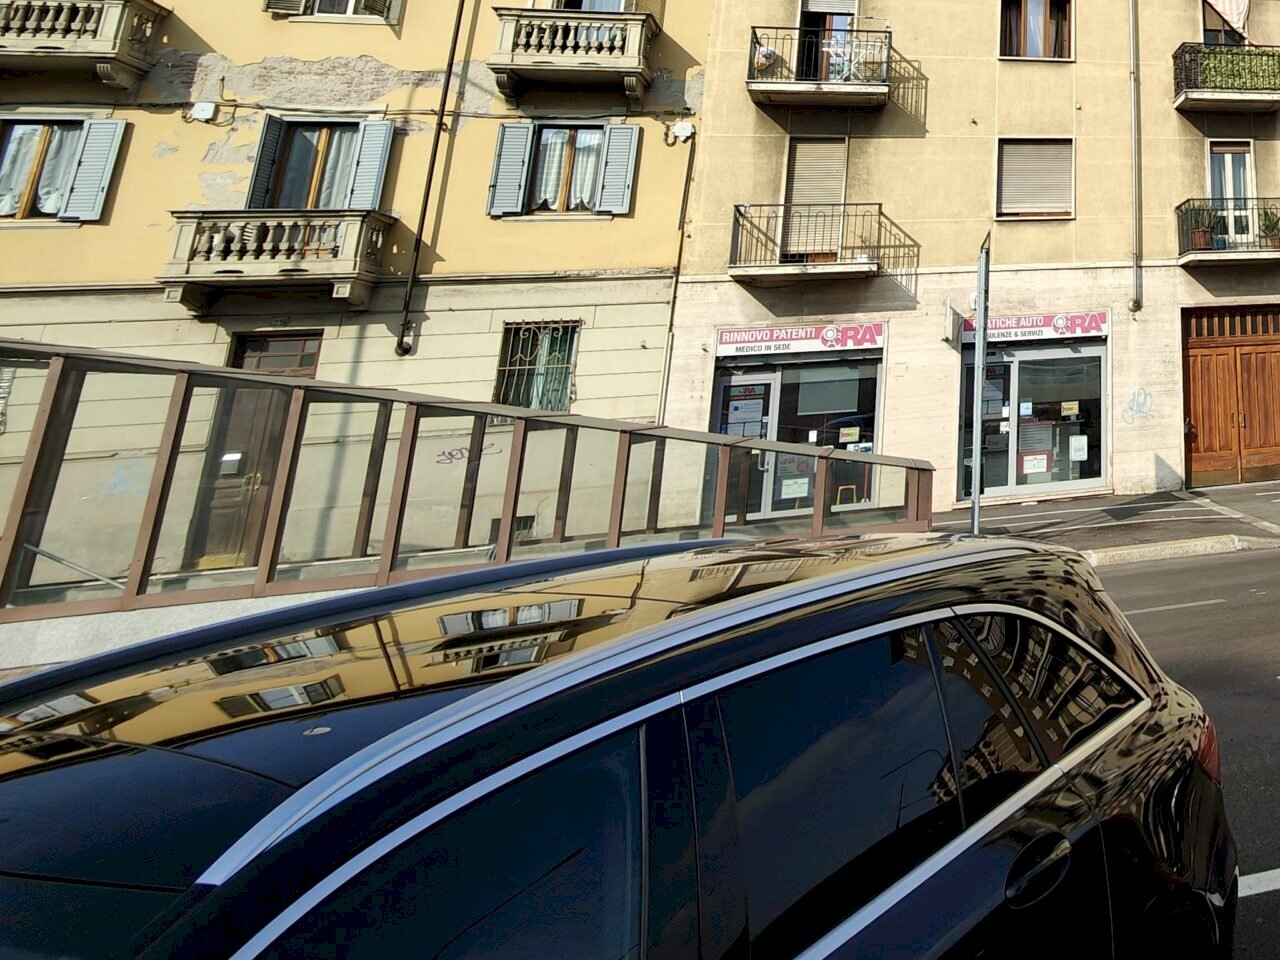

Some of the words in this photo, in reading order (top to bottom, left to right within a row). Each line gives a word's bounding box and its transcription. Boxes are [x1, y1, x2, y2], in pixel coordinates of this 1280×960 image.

[972, 318, 1018, 329] PATICHE
[1019, 316, 1044, 327] AUTO
[722, 330, 770, 343] RINNOVO
[774, 327, 816, 340] PATENTI
[973, 331, 1013, 340] CSULENZE
[1020, 329, 1043, 337] SERVIZI
[735, 345, 763, 353] MEDICO
[764, 344, 772, 352] IN
[773, 343, 791, 351] SEDE
